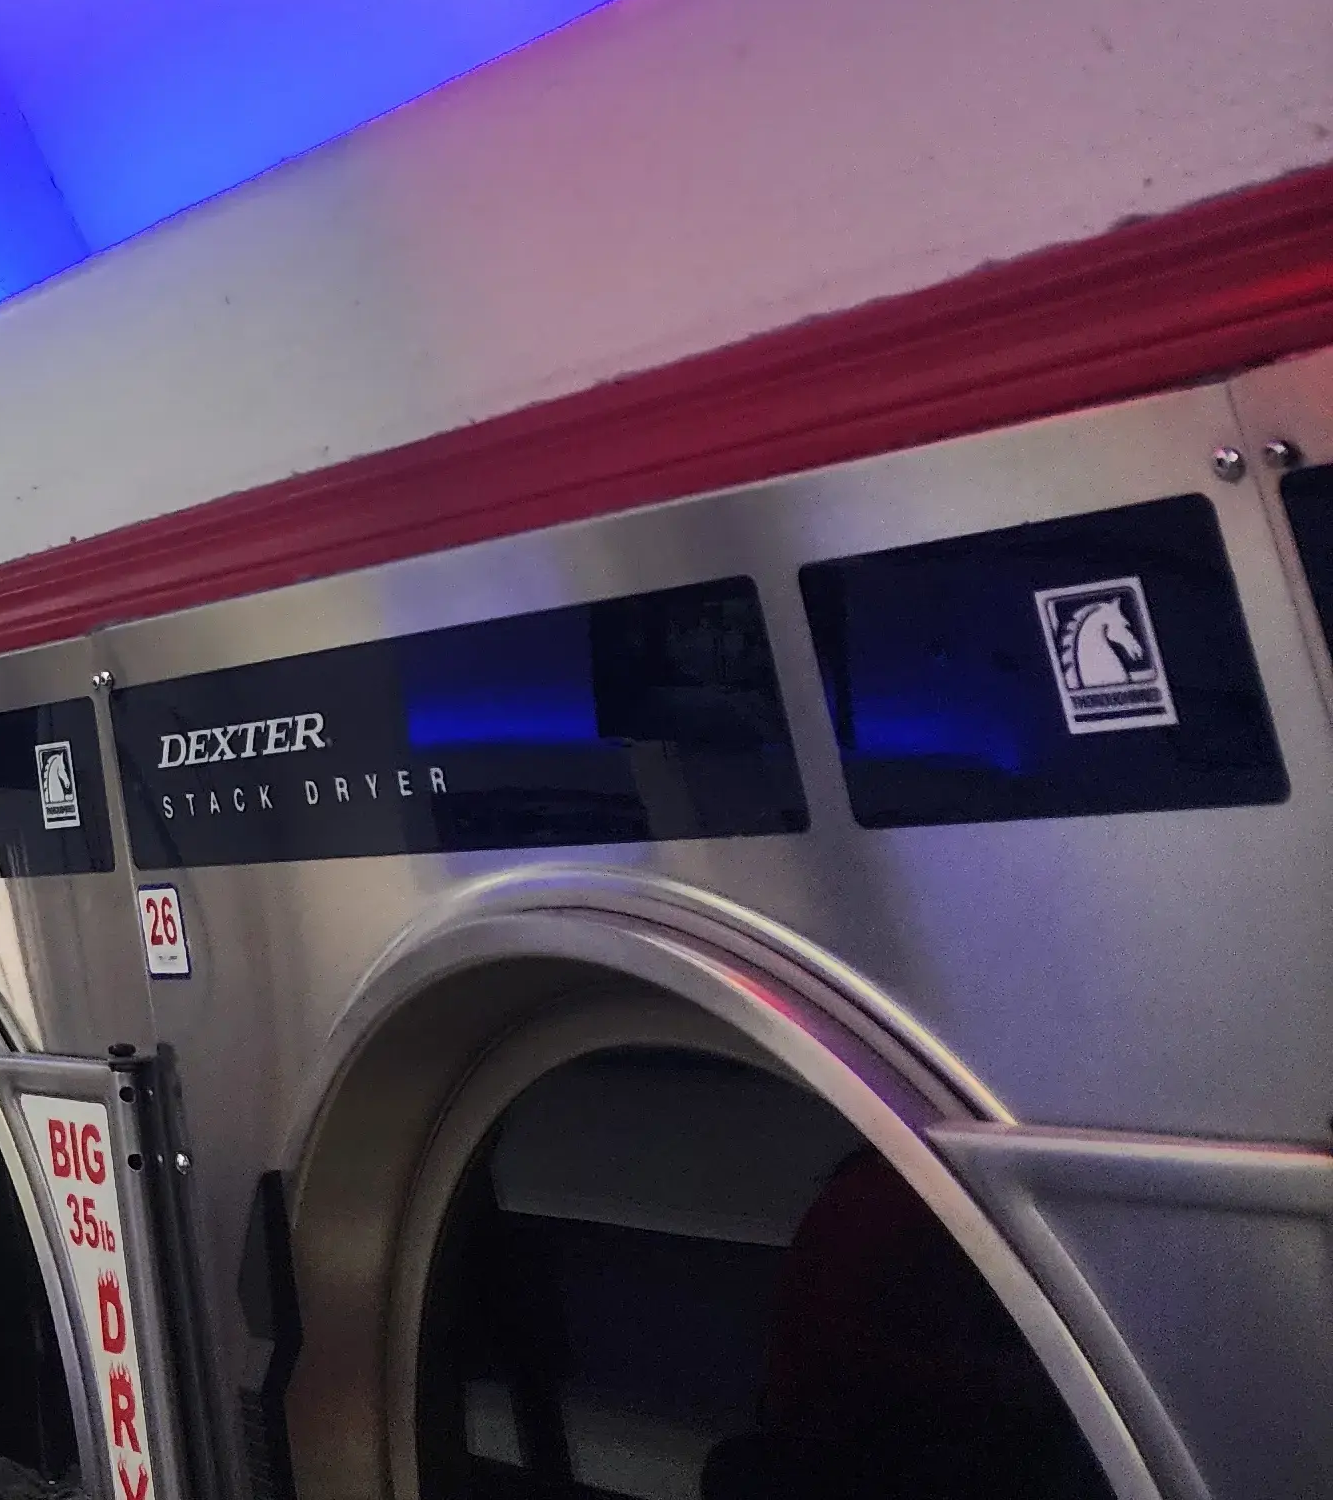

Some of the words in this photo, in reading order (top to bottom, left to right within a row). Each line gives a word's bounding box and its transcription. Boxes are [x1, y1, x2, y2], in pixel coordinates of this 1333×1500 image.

[157, 712, 327, 769] DEXTER
[162, 785, 274, 820] STACK
[304, 766, 448, 806] DRYER
[145, 895, 179, 947] 26
[48, 1117, 107, 1186] BIG
[66, 1192, 117, 1254] 35lb
